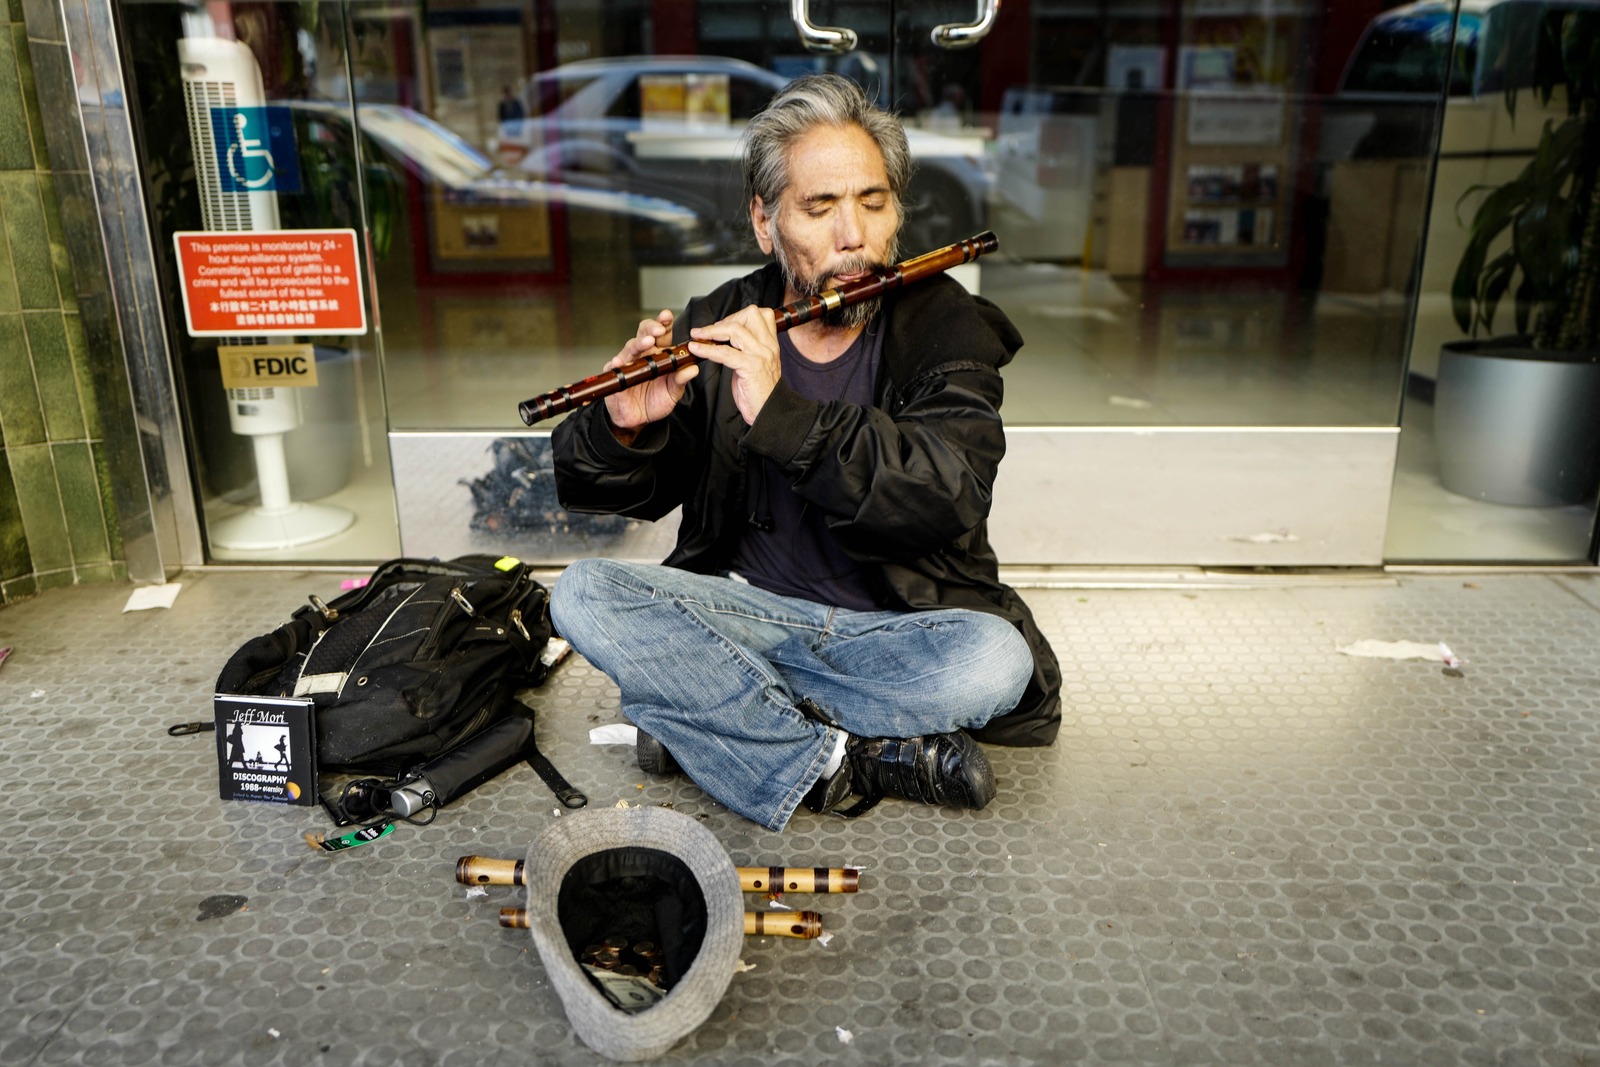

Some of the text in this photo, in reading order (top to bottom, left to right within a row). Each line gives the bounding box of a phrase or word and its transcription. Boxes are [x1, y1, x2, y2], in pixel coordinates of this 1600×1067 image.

[191, 242, 210, 252] This
[212, 242, 250, 254] premise
[252, 241, 260, 251] is
[262, 240, 308, 251] monitored
[309, 240, 321, 252] by
[323, 240, 335, 250] 24
[208, 253, 323, 265] hour surveillance system.
[198, 265, 250, 276] Committing
[252, 266, 264, 274] an
[266, 265, 281, 274] act
[282, 265, 292, 274] of
[294, 264, 322, 275] graffiti
[324, 264, 332, 273] is
[193, 275, 349, 288] crime and will be prosecuted to the
[220, 288, 248, 298] fullest
[250, 288, 278, 297] extent
[279, 288, 289, 297] of
[290, 288, 305, 297] the
[254, 357, 308, 376] FDIC
[232, 709, 285, 725] Jeff Mori
[233, 772, 287, 784] DISCOGRAPHY
[263, 786, 284, 794] eternity
